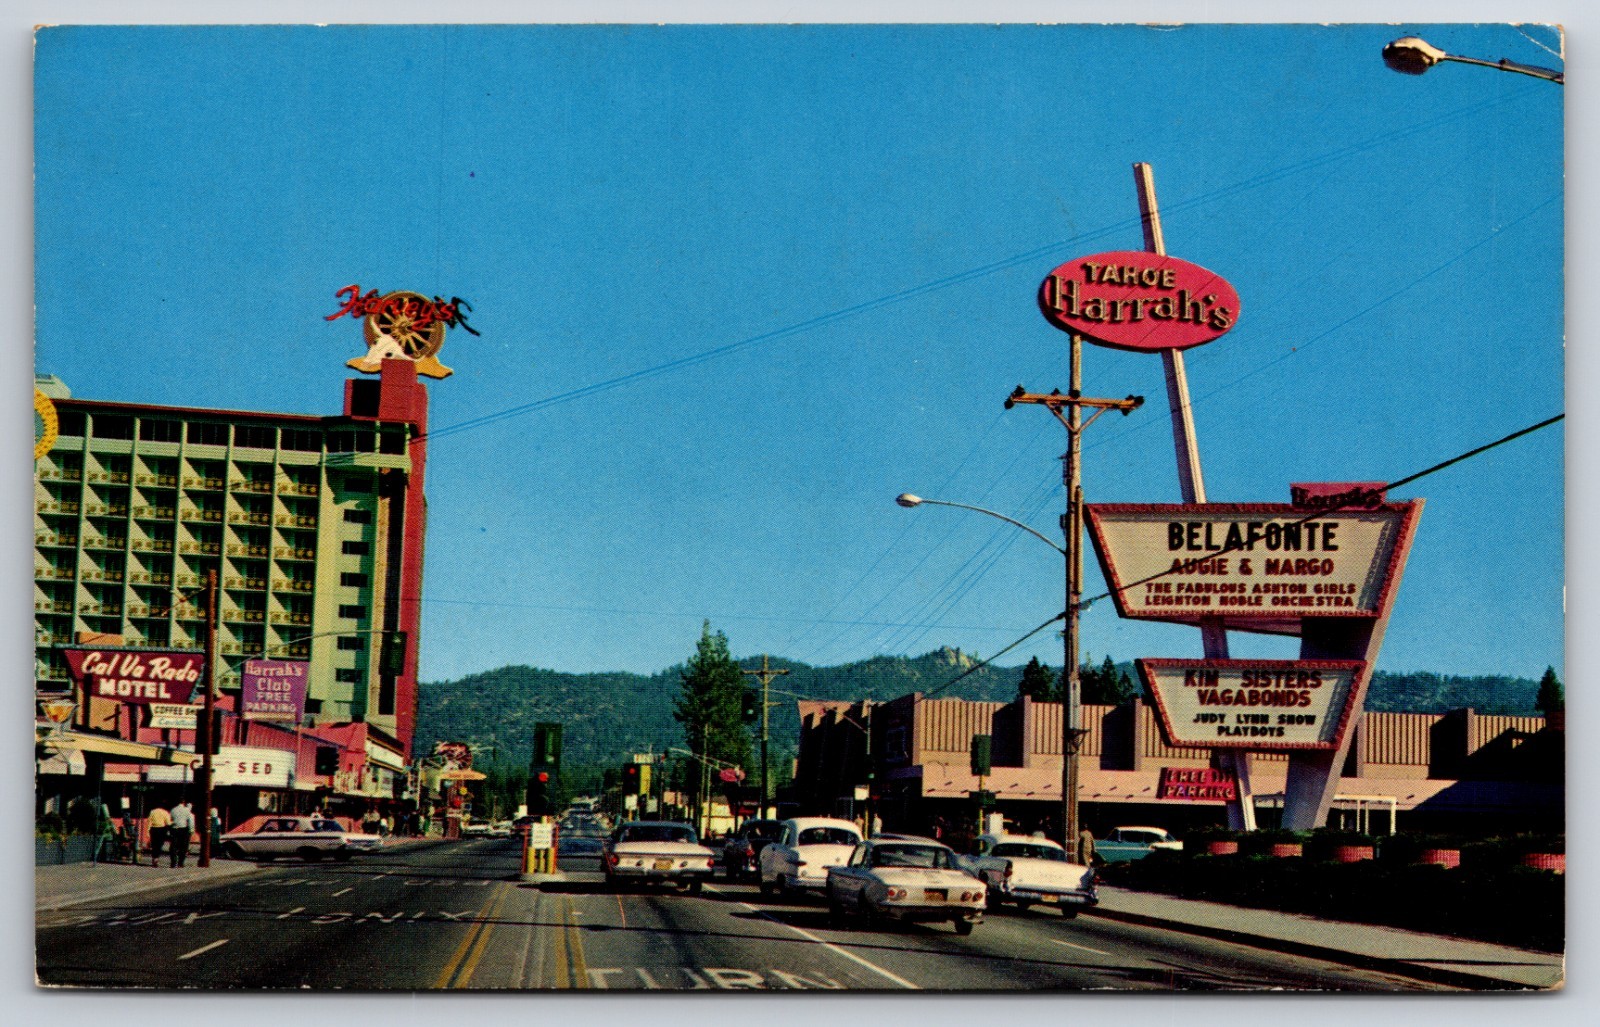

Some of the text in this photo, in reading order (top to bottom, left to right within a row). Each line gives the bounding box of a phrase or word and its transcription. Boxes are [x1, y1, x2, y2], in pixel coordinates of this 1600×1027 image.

[1085, 262, 1176, 288] TAHOE
[1050, 274, 1233, 330] Harrah's
[1168, 522, 1339, 551] BELAFONTE
[1171, 557, 1335, 576] AUGIE & MARGO
[1145, 582, 1357, 595] THE FABULOUS ASHTON GIRLS
[1145, 595, 1355, 608] LEIGHTON NOBLE ORCHESTRA
[81, 652, 199, 683] Cal Va Rado
[256, 678, 291, 691] Club
[1183, 669, 1323, 689] KIM SISTERS
[99, 678, 172, 699] MOTEL
[256, 691, 291, 702] FREE
[1197, 689, 1312, 708] VAGABONDS
[153, 705, 184, 716] COFFEE
[245, 701, 297, 713] PARKING
[1192, 713, 1317, 726] JUDY LYNN SHOW
[1217, 726, 1285, 738] PLAYBOYS
[1168, 770, 1208, 784] FREE
[1166, 785, 1234, 799] PARKING
